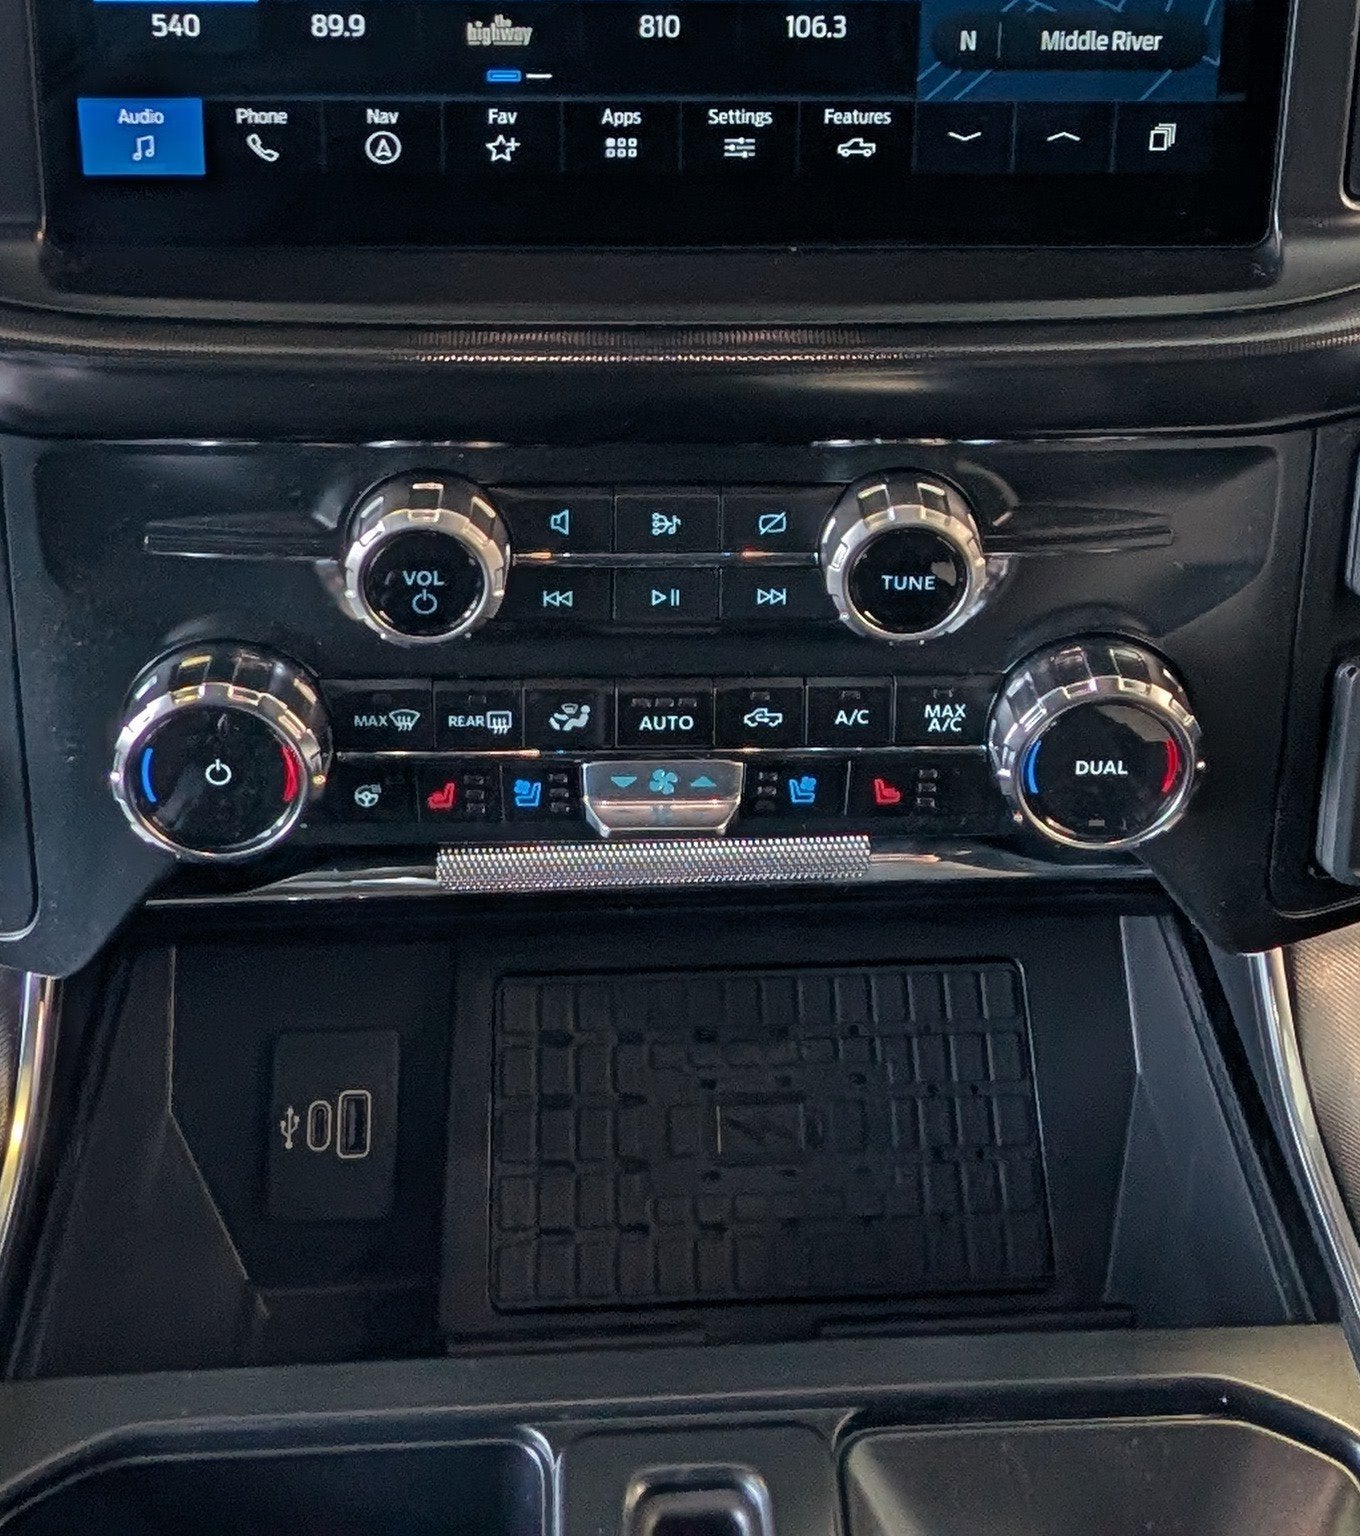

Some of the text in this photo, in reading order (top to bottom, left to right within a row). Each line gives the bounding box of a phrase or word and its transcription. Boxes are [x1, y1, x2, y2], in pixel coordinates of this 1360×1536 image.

[151, 13, 200, 37] 540
[311, 13, 365, 37] 89.9
[639, 14, 680, 38] 810
[785, 14, 847, 39] 106.3
[960, 30, 977, 51] N
[1041, 30, 1164, 52] Middle River
[117, 108, 165, 125] Audio
[235, 107, 288, 125] Phone
[366, 108, 399, 125] Nav
[488, 108, 518, 125] Fav
[601, 108, 642, 127] Apps
[708, 108, 773, 128] Settings
[824, 108, 892, 125] Features
[402, 570, 445, 587] VOL
[881, 574, 936, 591] TUNE
[834, 708, 869, 726] A/C
[923, 704, 966, 718] MAX
[353, 714, 388, 728] MAX
[447, 714, 484, 728] REAR
[639, 715, 694, 731] AUTO
[927, 718, 962, 733] A/C
[1075, 760, 1129, 776] DUAL
